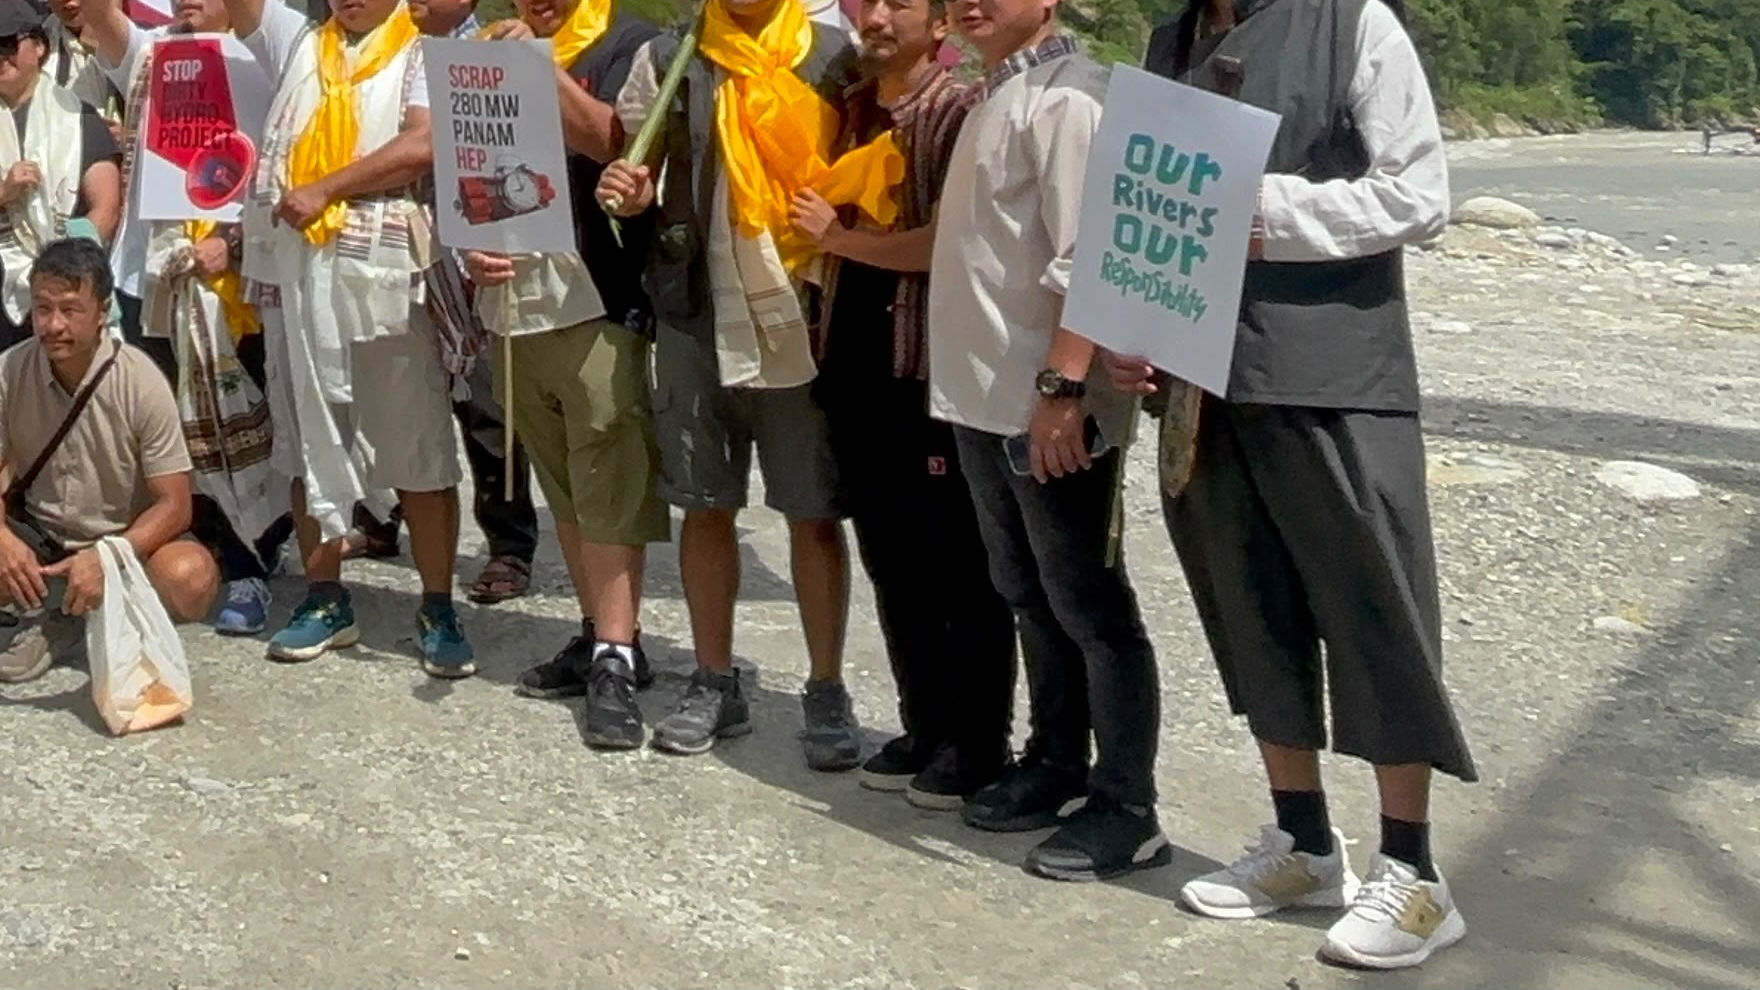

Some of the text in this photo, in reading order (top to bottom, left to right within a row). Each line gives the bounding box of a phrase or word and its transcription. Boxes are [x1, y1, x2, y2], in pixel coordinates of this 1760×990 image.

[162, 59, 203, 82] STOP
[448, 64, 505, 90] SCRAP
[450, 92, 520, 118] 280 MW
[157, 125, 234, 149] PROJECT
[452, 119, 515, 146] PANAM
[455, 146, 487, 172] HEP
